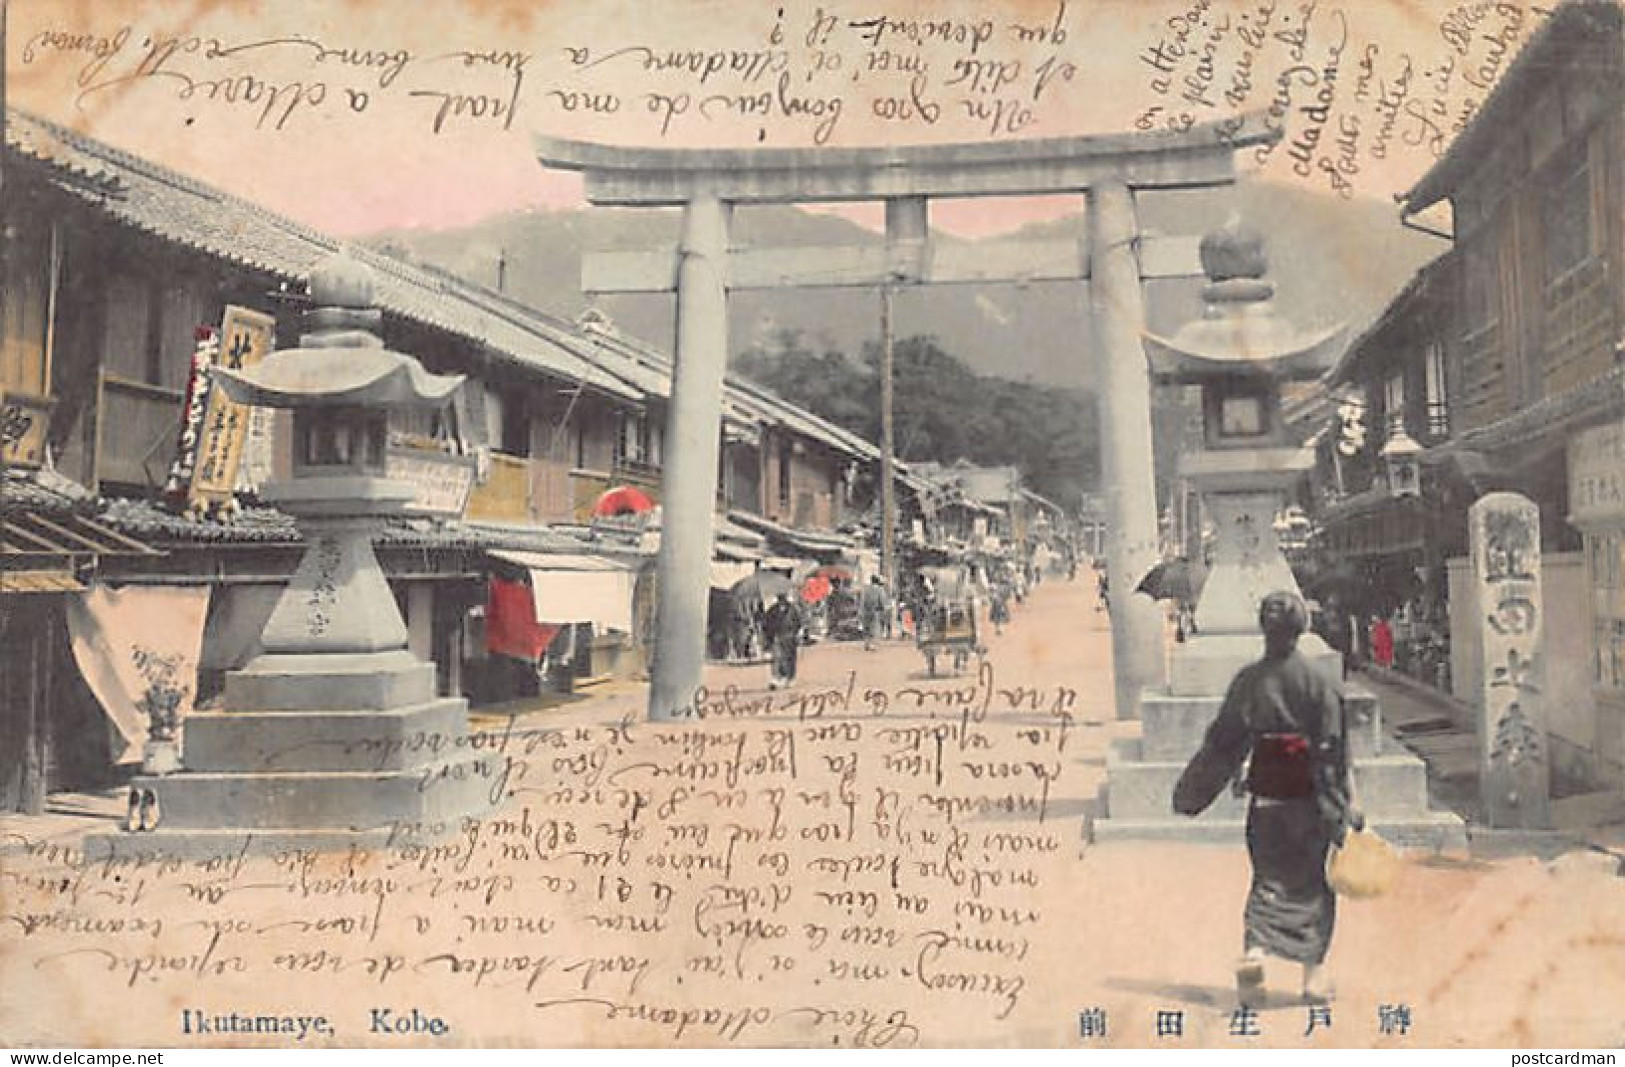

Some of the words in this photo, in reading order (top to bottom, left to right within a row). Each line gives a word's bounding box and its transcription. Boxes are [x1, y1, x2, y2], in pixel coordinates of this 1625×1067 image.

[1010, 1, 1067, 44] que
[445, 51, 526, 79] une
[585, 46, 788, 84] Madame
[852, 52, 923, 84] moi
[1032, 54, 1077, 101] et
[545, 91, 619, 113] ma
[646, 94, 689, 135] de
[874, 81, 940, 122] gros
[822, 752, 857, 784] la
[724, 801, 787, 845] que
[801, 801, 855, 843] pas
[983, 834, 1059, 861] mais
[758, 853, 790, 877] les
[175, 884, 225, 905] au
[651, 883, 672, 915] le
[814, 892, 878, 918] lieu
[893, 893, 929, 913] au
[585, 915, 666, 936] mon
[953, 902, 1039, 930] mais
[802, 924, 828, 951] le
[367, 955, 405, 983] de
[536, 999, 770, 1041] Madame
